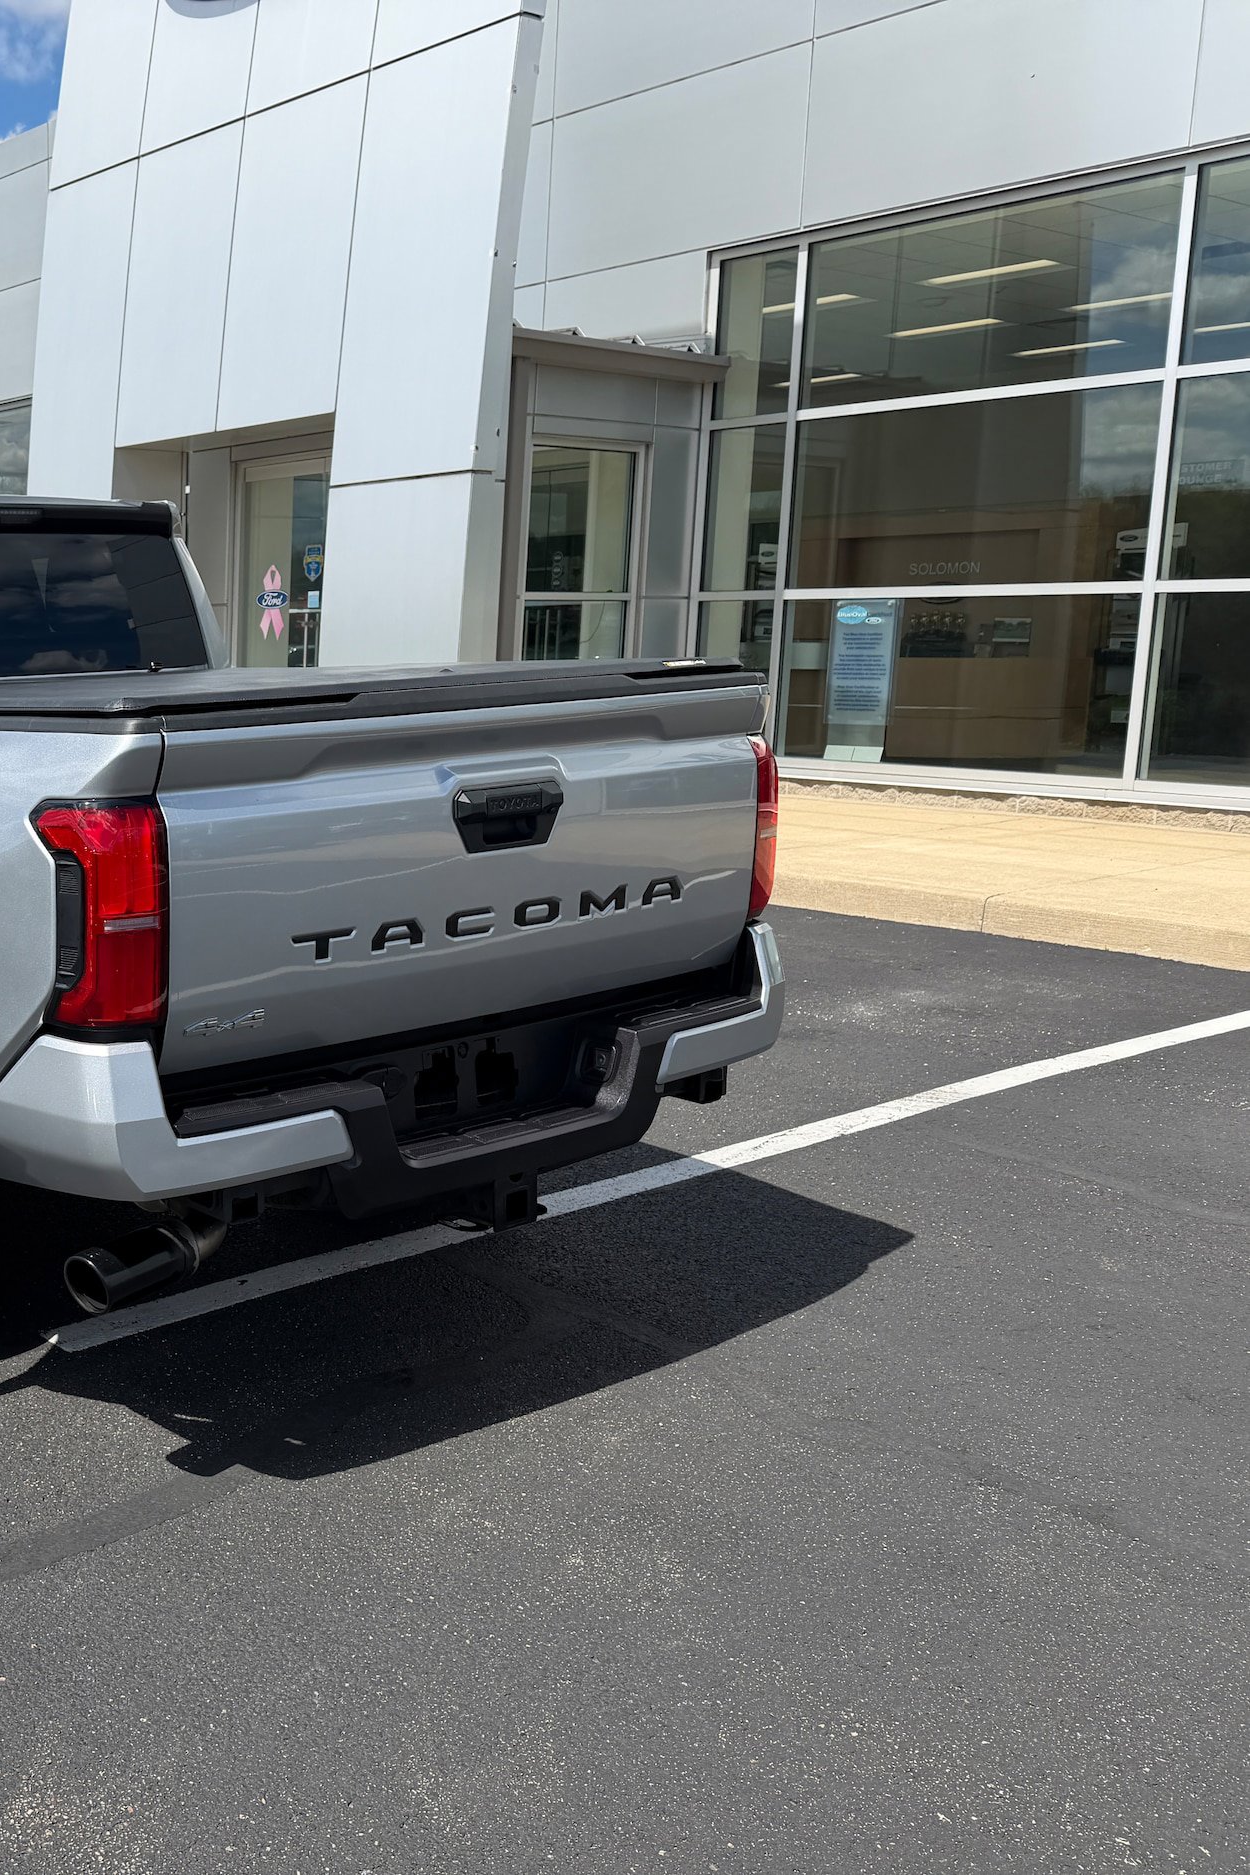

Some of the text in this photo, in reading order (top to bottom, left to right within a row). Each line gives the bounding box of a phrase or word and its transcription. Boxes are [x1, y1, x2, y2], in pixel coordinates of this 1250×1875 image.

[1180, 461, 1232, 473] STOMER
[1178, 473, 1222, 485] OUNGE
[909, 561, 981, 576] SOLOMON
[261, 592, 284, 606] Ford
[490, 794, 540, 813] TOYOTA
[291, 874, 685, 965] TACOMA
